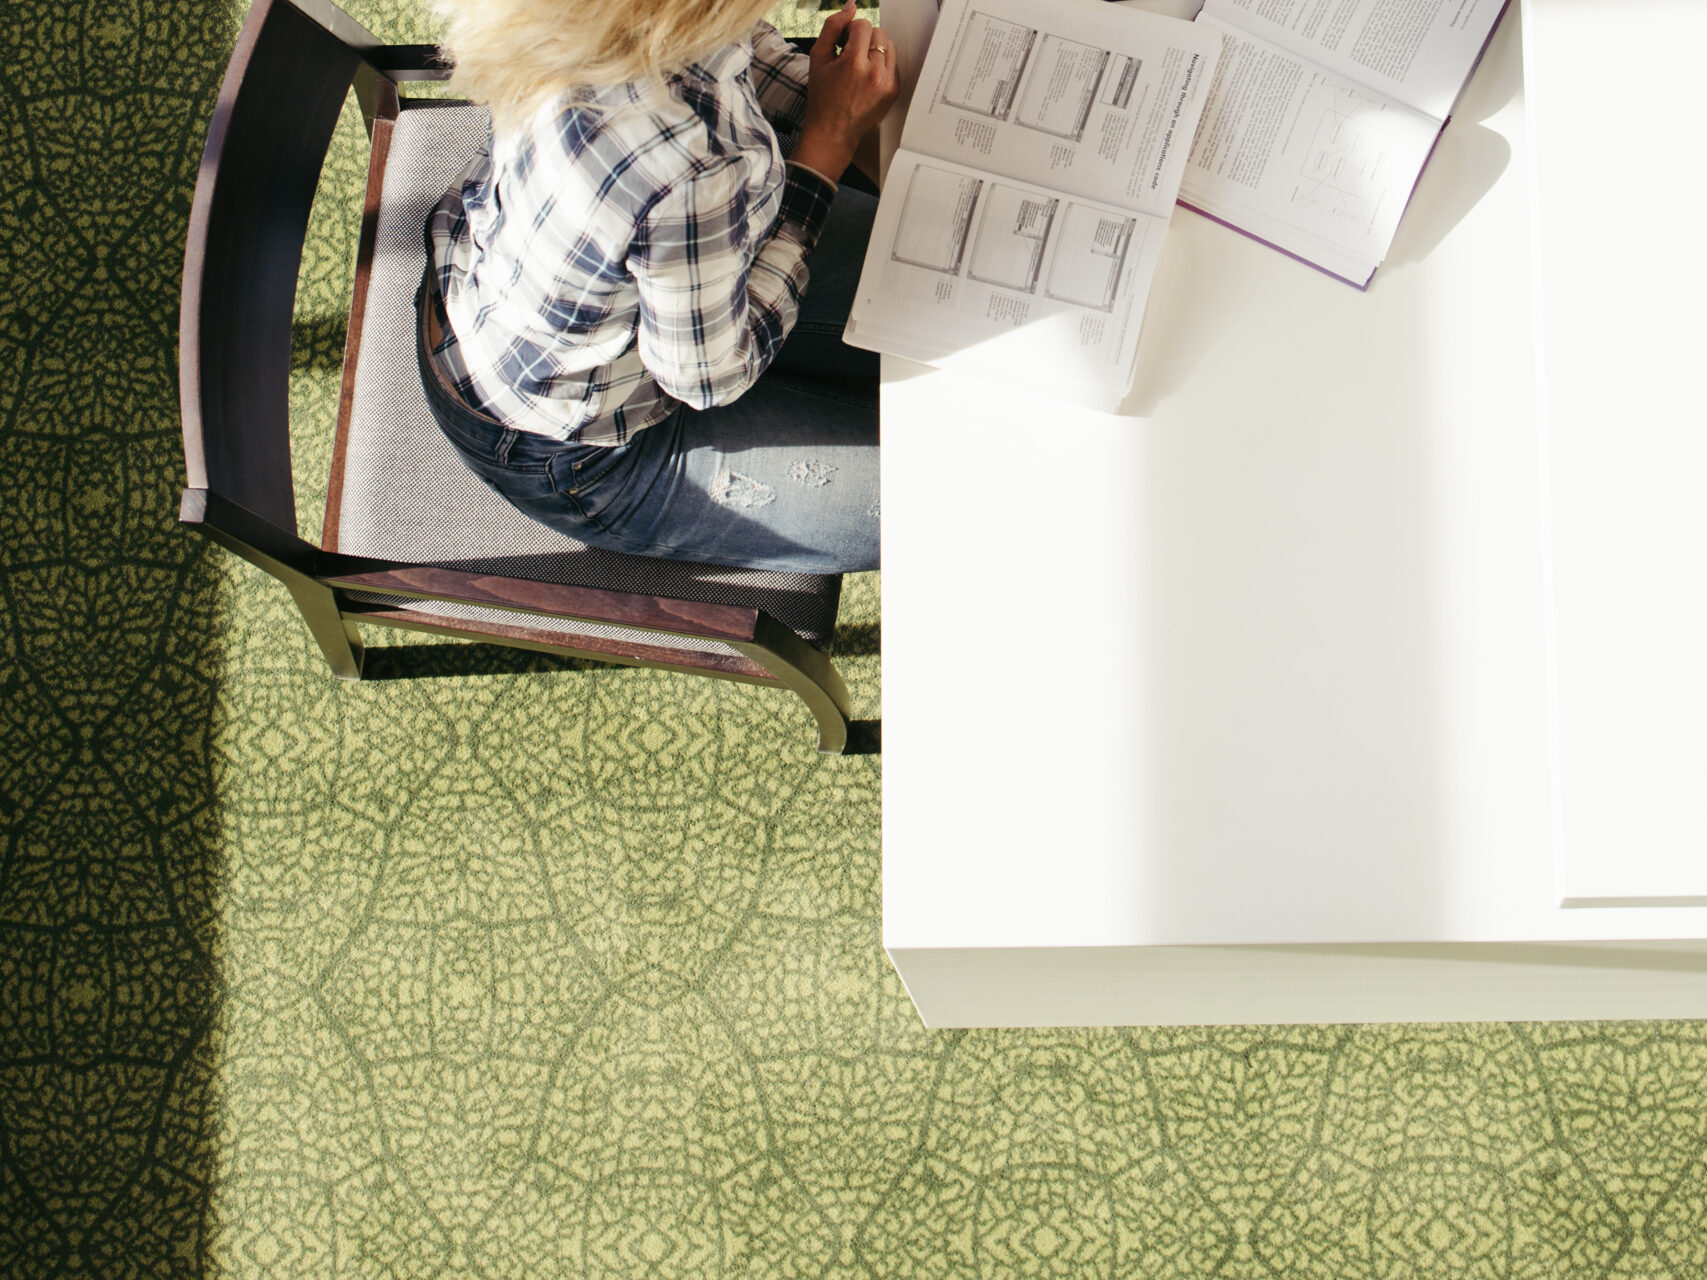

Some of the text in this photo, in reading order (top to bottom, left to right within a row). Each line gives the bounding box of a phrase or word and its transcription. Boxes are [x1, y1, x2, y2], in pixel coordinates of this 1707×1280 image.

[1150, 52, 1199, 190] Navigating through an applications code
